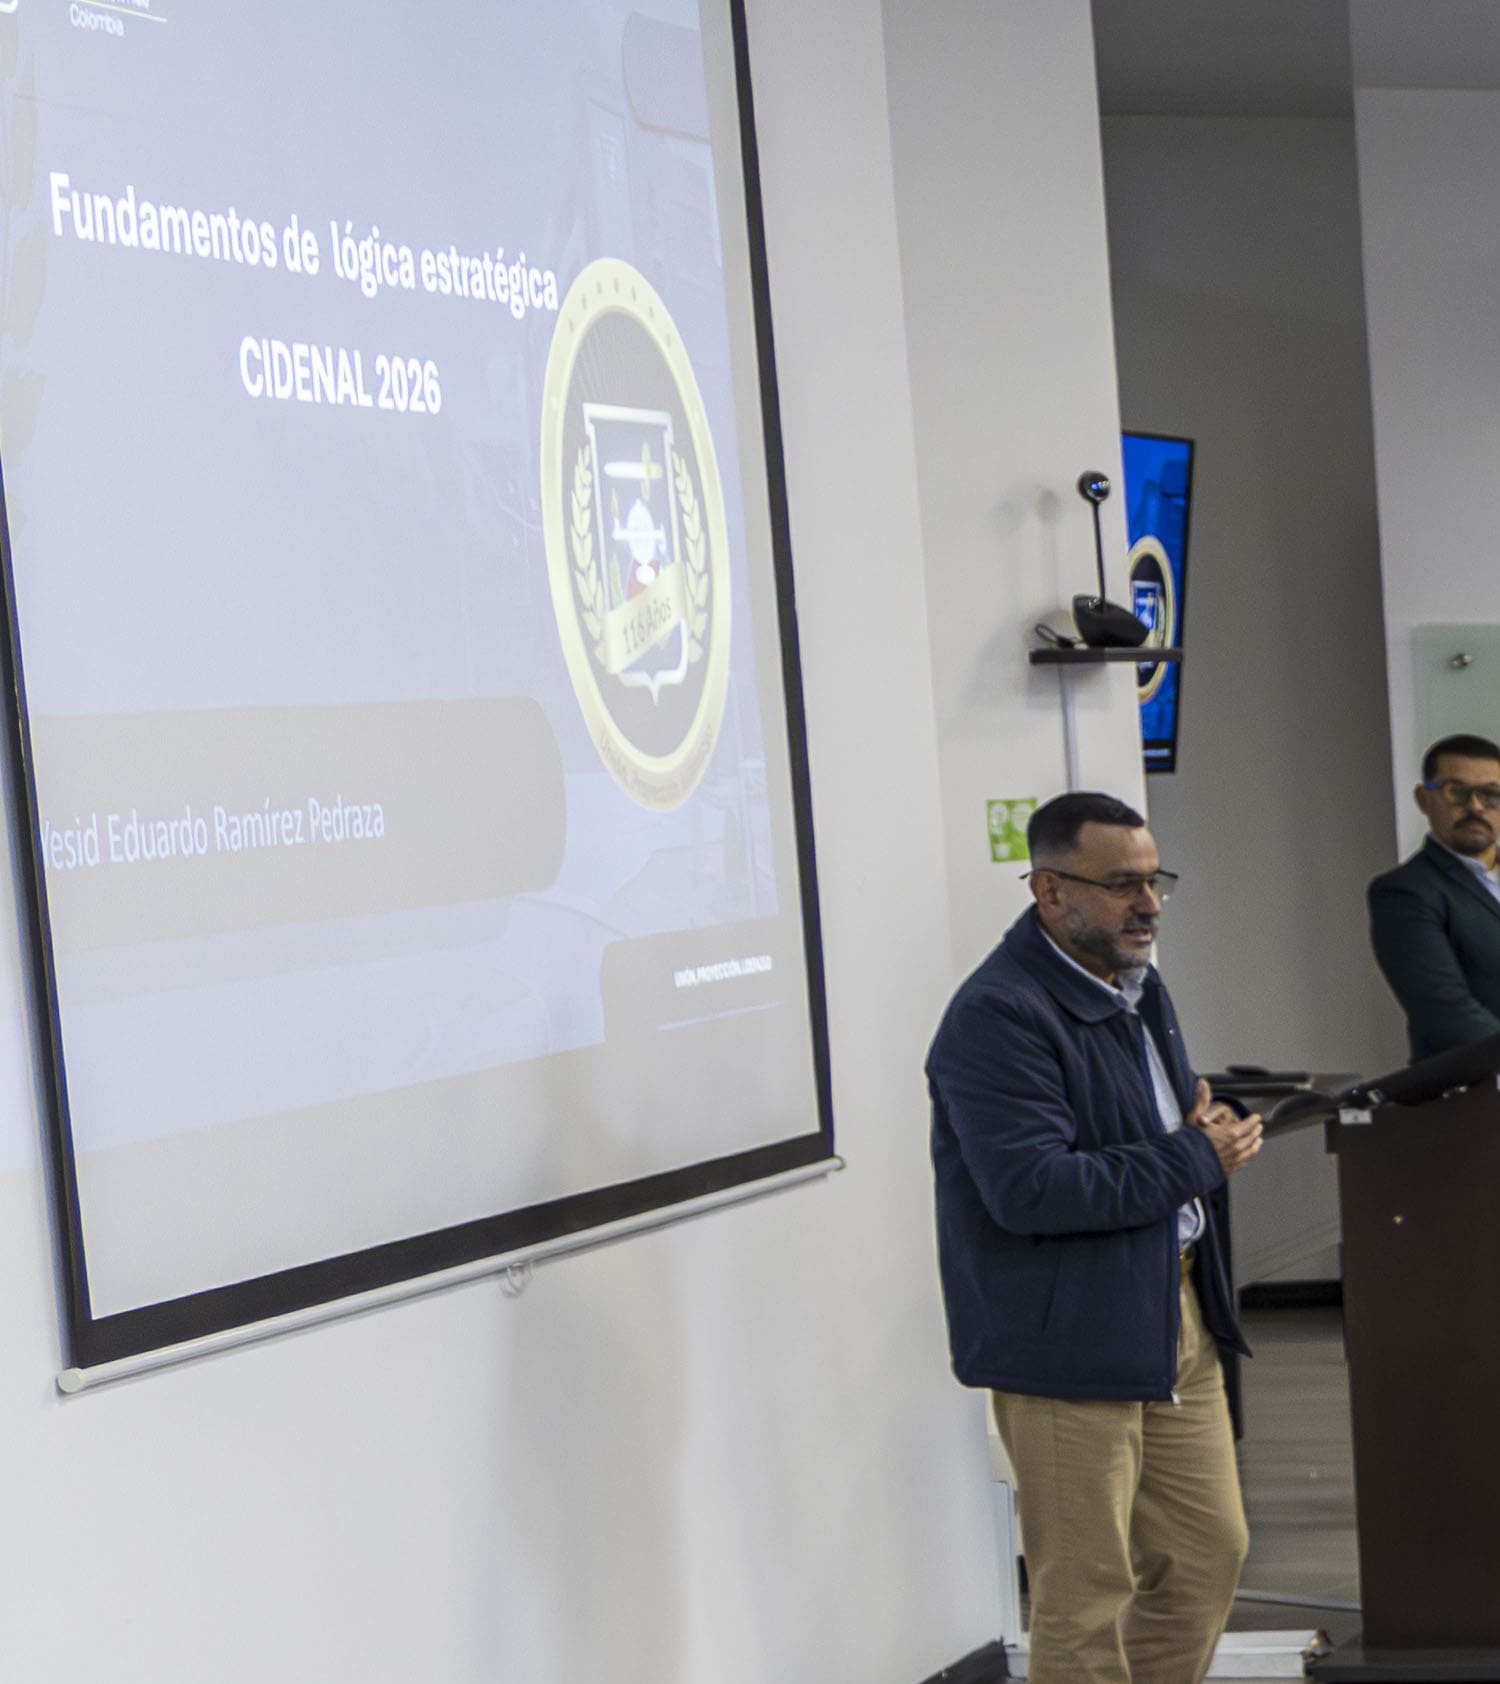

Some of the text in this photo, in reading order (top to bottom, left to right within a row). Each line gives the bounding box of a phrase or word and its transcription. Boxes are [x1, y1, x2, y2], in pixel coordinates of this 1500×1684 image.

[50, 171, 559, 320] Fundamentos de lógica estratégica
[239, 335, 442, 415] CIDENAL 2026
[107, 804, 208, 864] Eduardo
[213, 797, 304, 852] Ramírez
[307, 792, 385, 843] Pedraza
